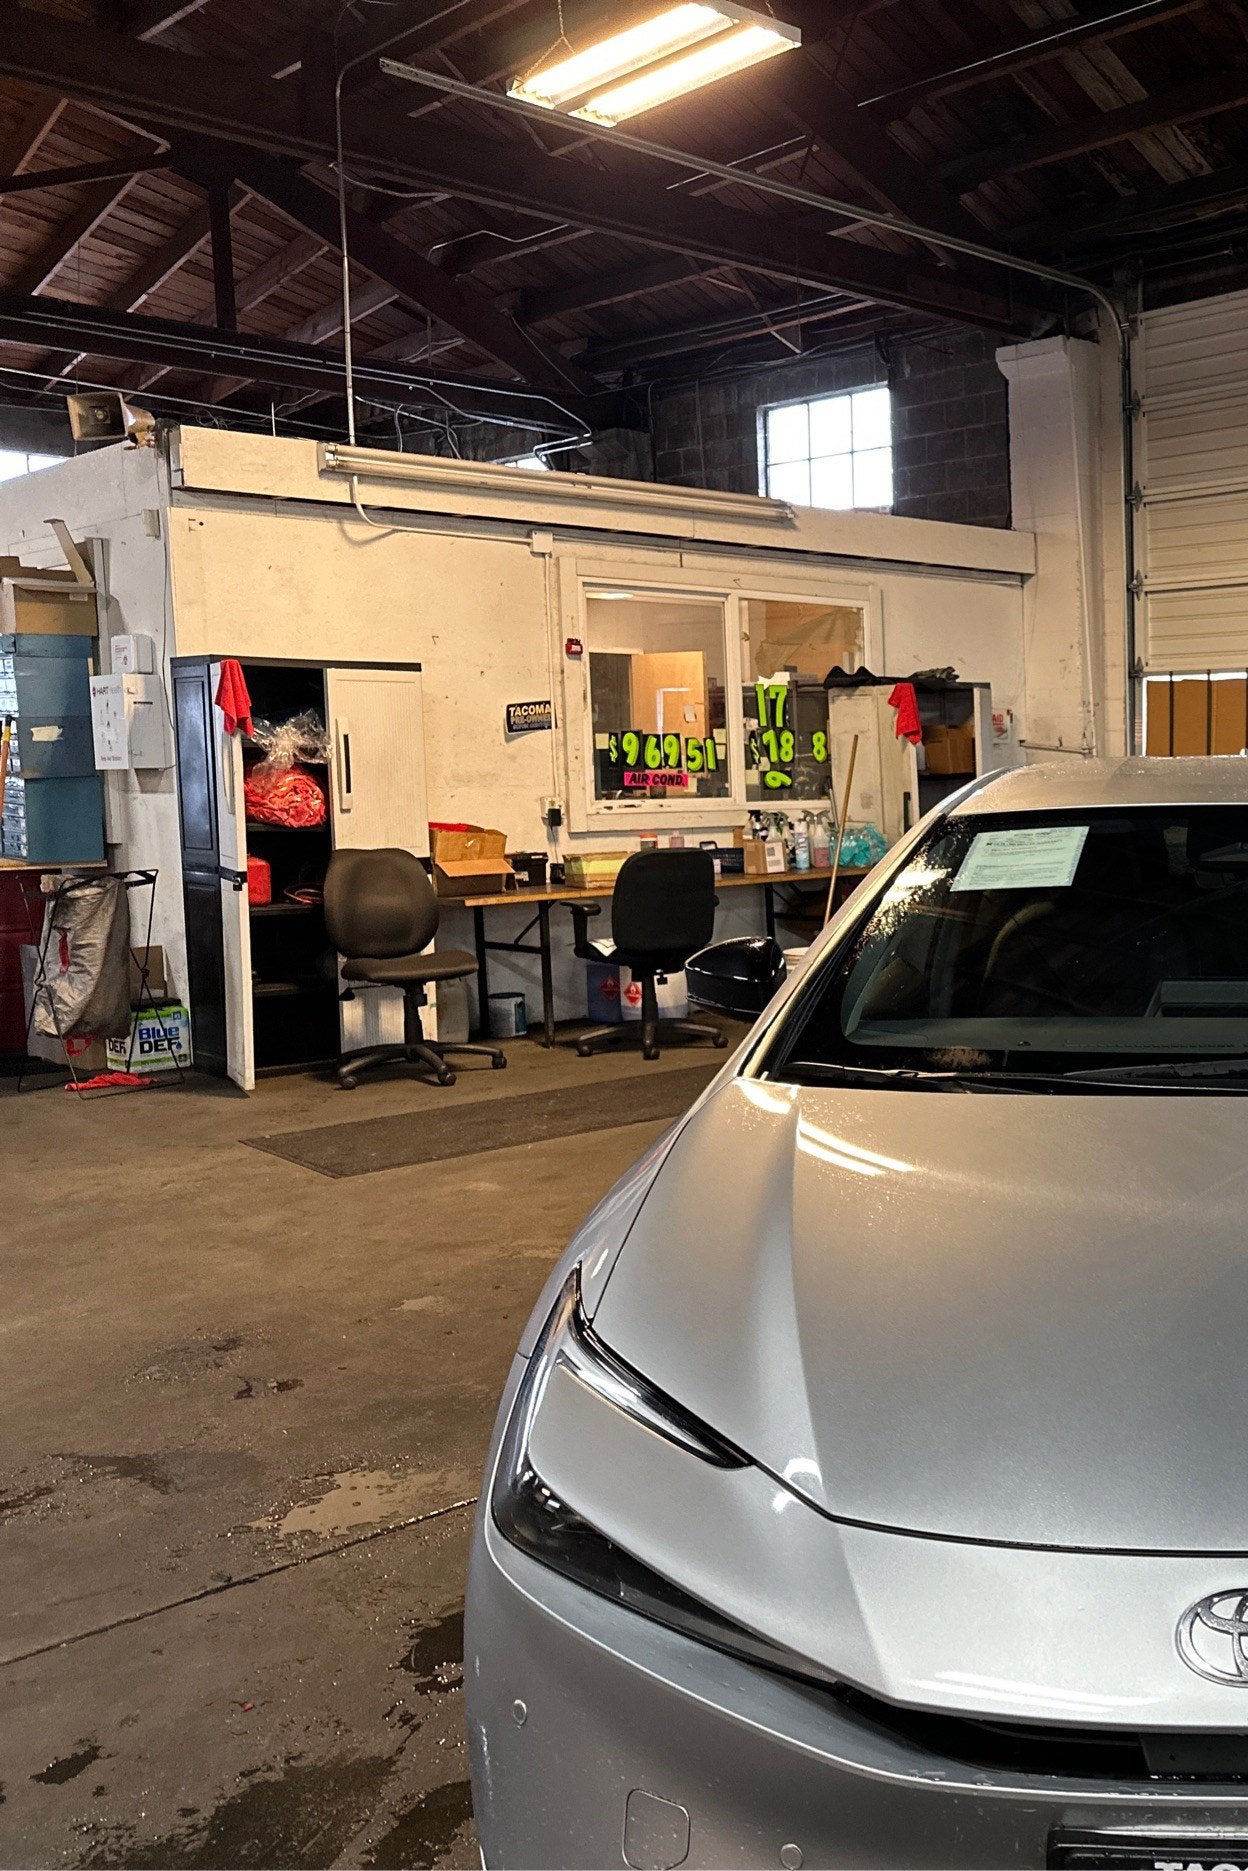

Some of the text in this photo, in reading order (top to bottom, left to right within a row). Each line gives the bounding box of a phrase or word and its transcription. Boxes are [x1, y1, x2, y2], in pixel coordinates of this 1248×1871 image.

[509, 704, 551, 717] TACOMA
[755, 684, 788, 727] 17
[629, 773, 651, 786] AIR
[139, 1026, 180, 1041] Blue
[140, 1037, 179, 1055] DEF
